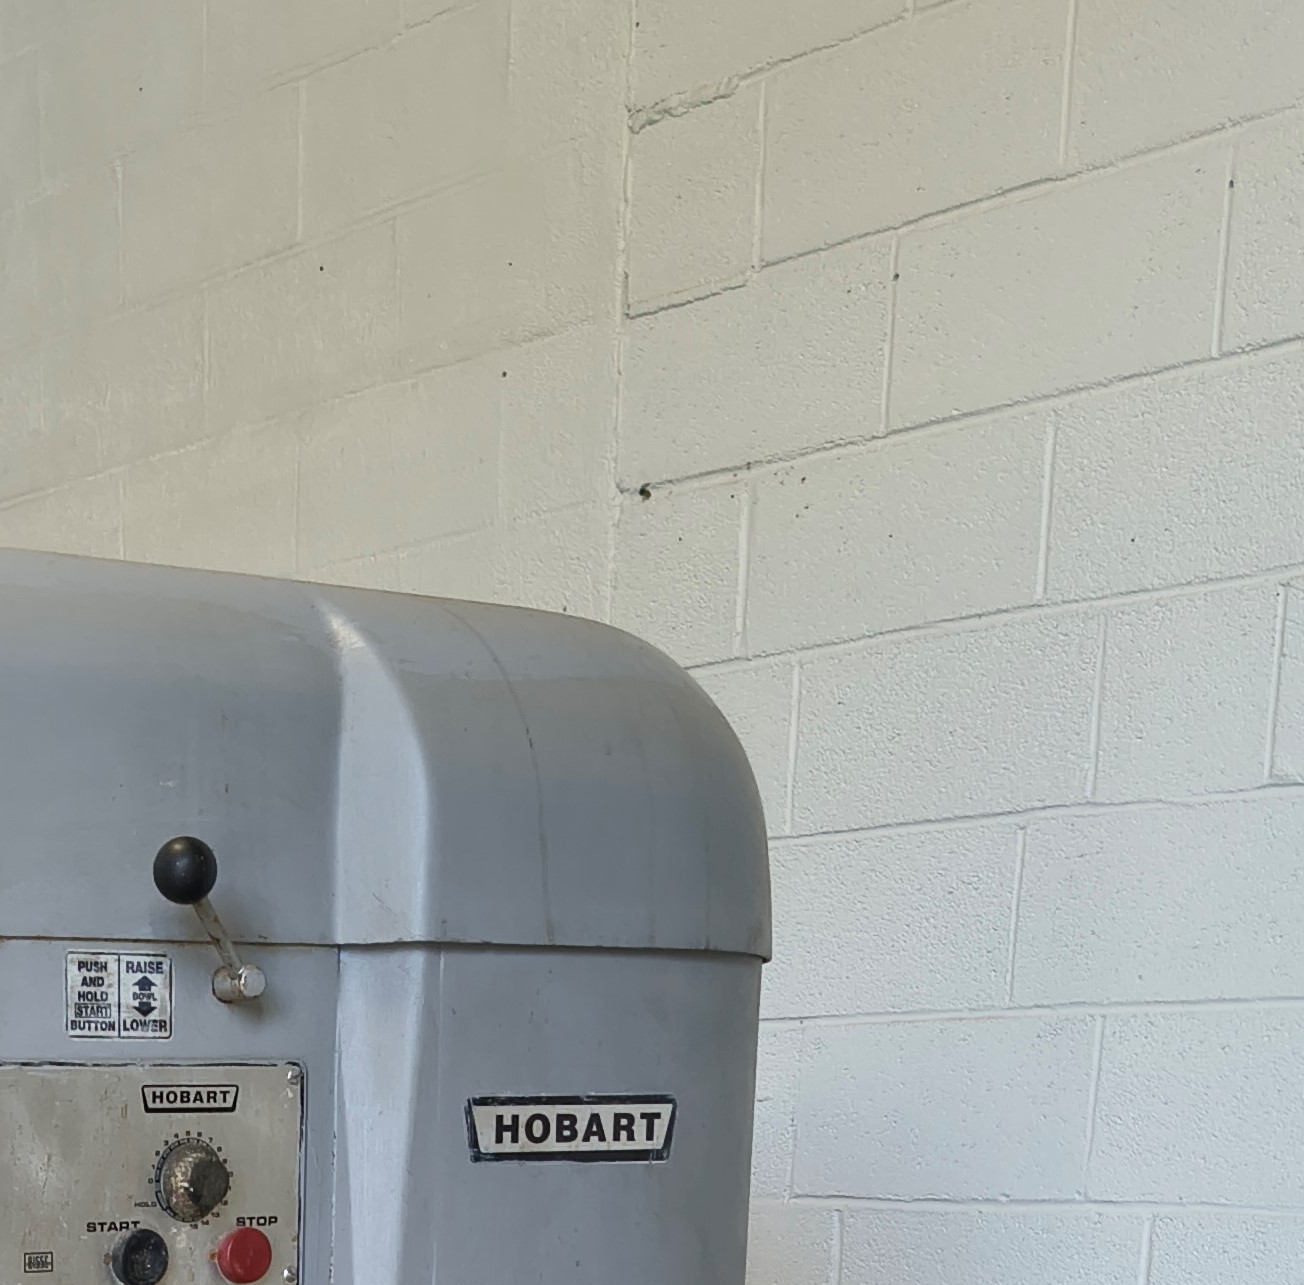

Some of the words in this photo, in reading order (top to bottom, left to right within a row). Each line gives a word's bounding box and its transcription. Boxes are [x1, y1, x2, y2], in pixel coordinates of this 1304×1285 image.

[77, 960, 108, 973] PUSH
[125, 960, 164, 974] RAISE
[80, 975, 105, 988] AND
[77, 990, 109, 1002] HOLD
[132, 991, 158, 1002] BOWL
[75, 1004, 109, 1018] START
[70, 1020, 116, 1032] BUTTON
[122, 1018, 168, 1032] LOWER
[151, 1090, 231, 1104] HOBART
[494, 1112, 662, 1144] HOBART
[86, 1220, 141, 1233] START
[235, 1216, 278, 1228] STOP
